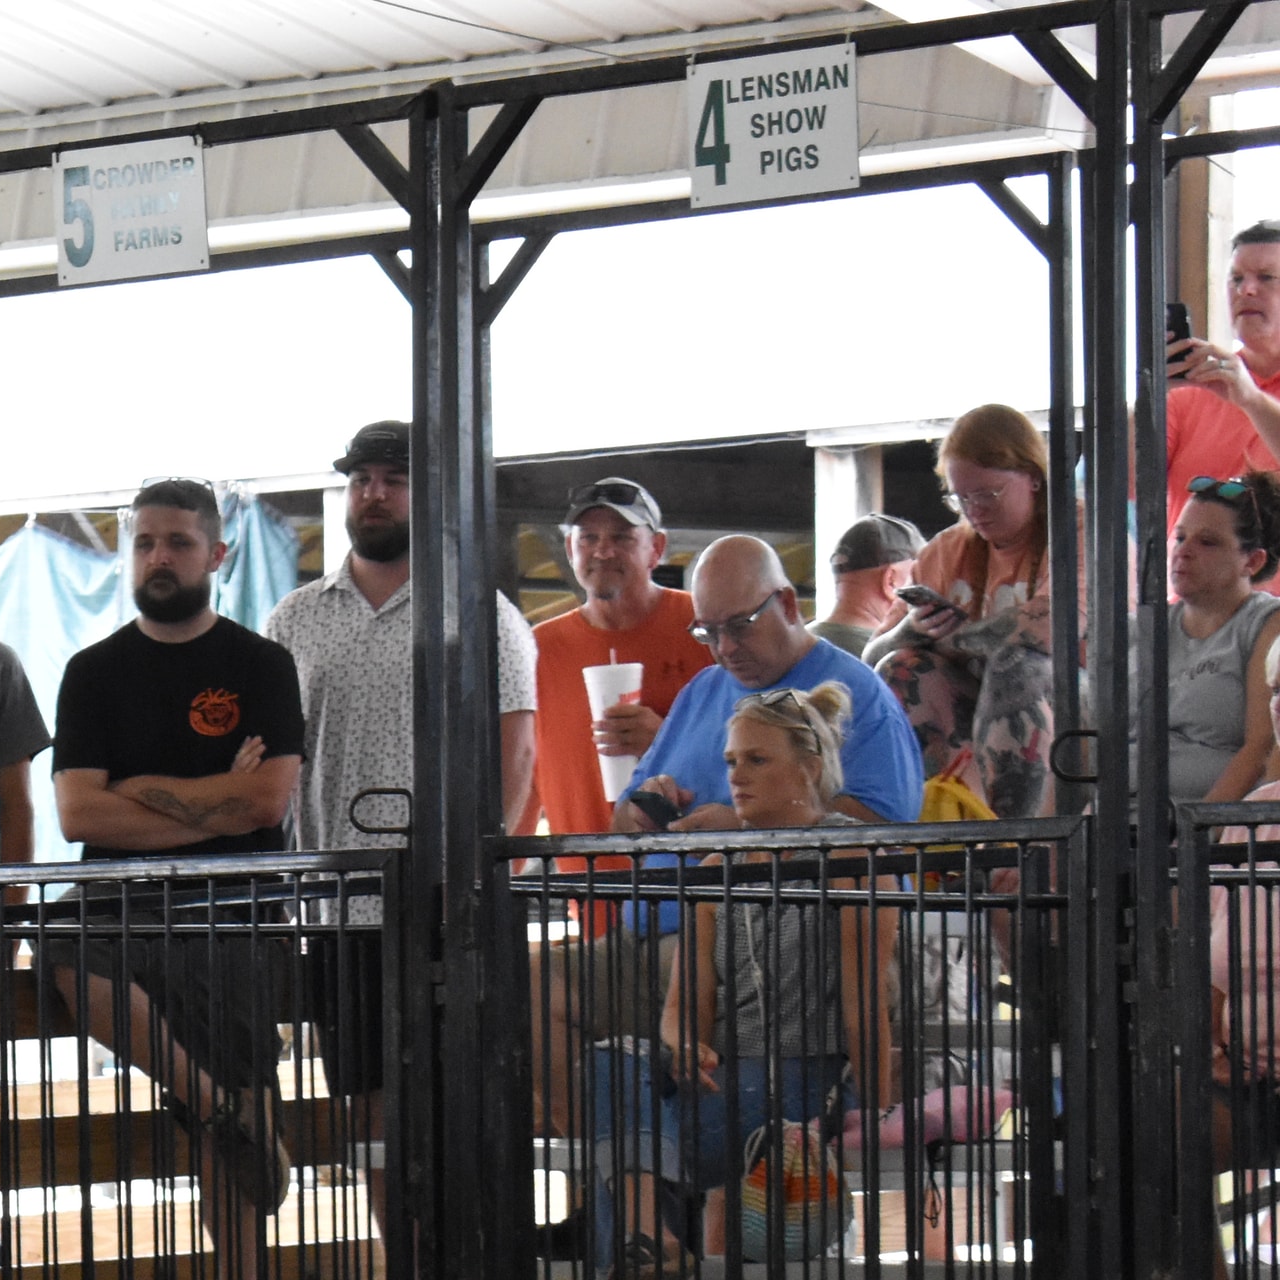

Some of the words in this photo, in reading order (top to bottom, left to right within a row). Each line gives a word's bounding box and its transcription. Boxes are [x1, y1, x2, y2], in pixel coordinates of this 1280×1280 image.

[726, 63, 849, 104] LENSMAN
[695, 79, 731, 186] 4
[750, 105, 827, 138] SHOW
[93, 157, 195, 190] CROWDER
[760, 144, 819, 175] PIGS
[63, 166, 94, 268] 5
[113, 225, 183, 252] FARMS
